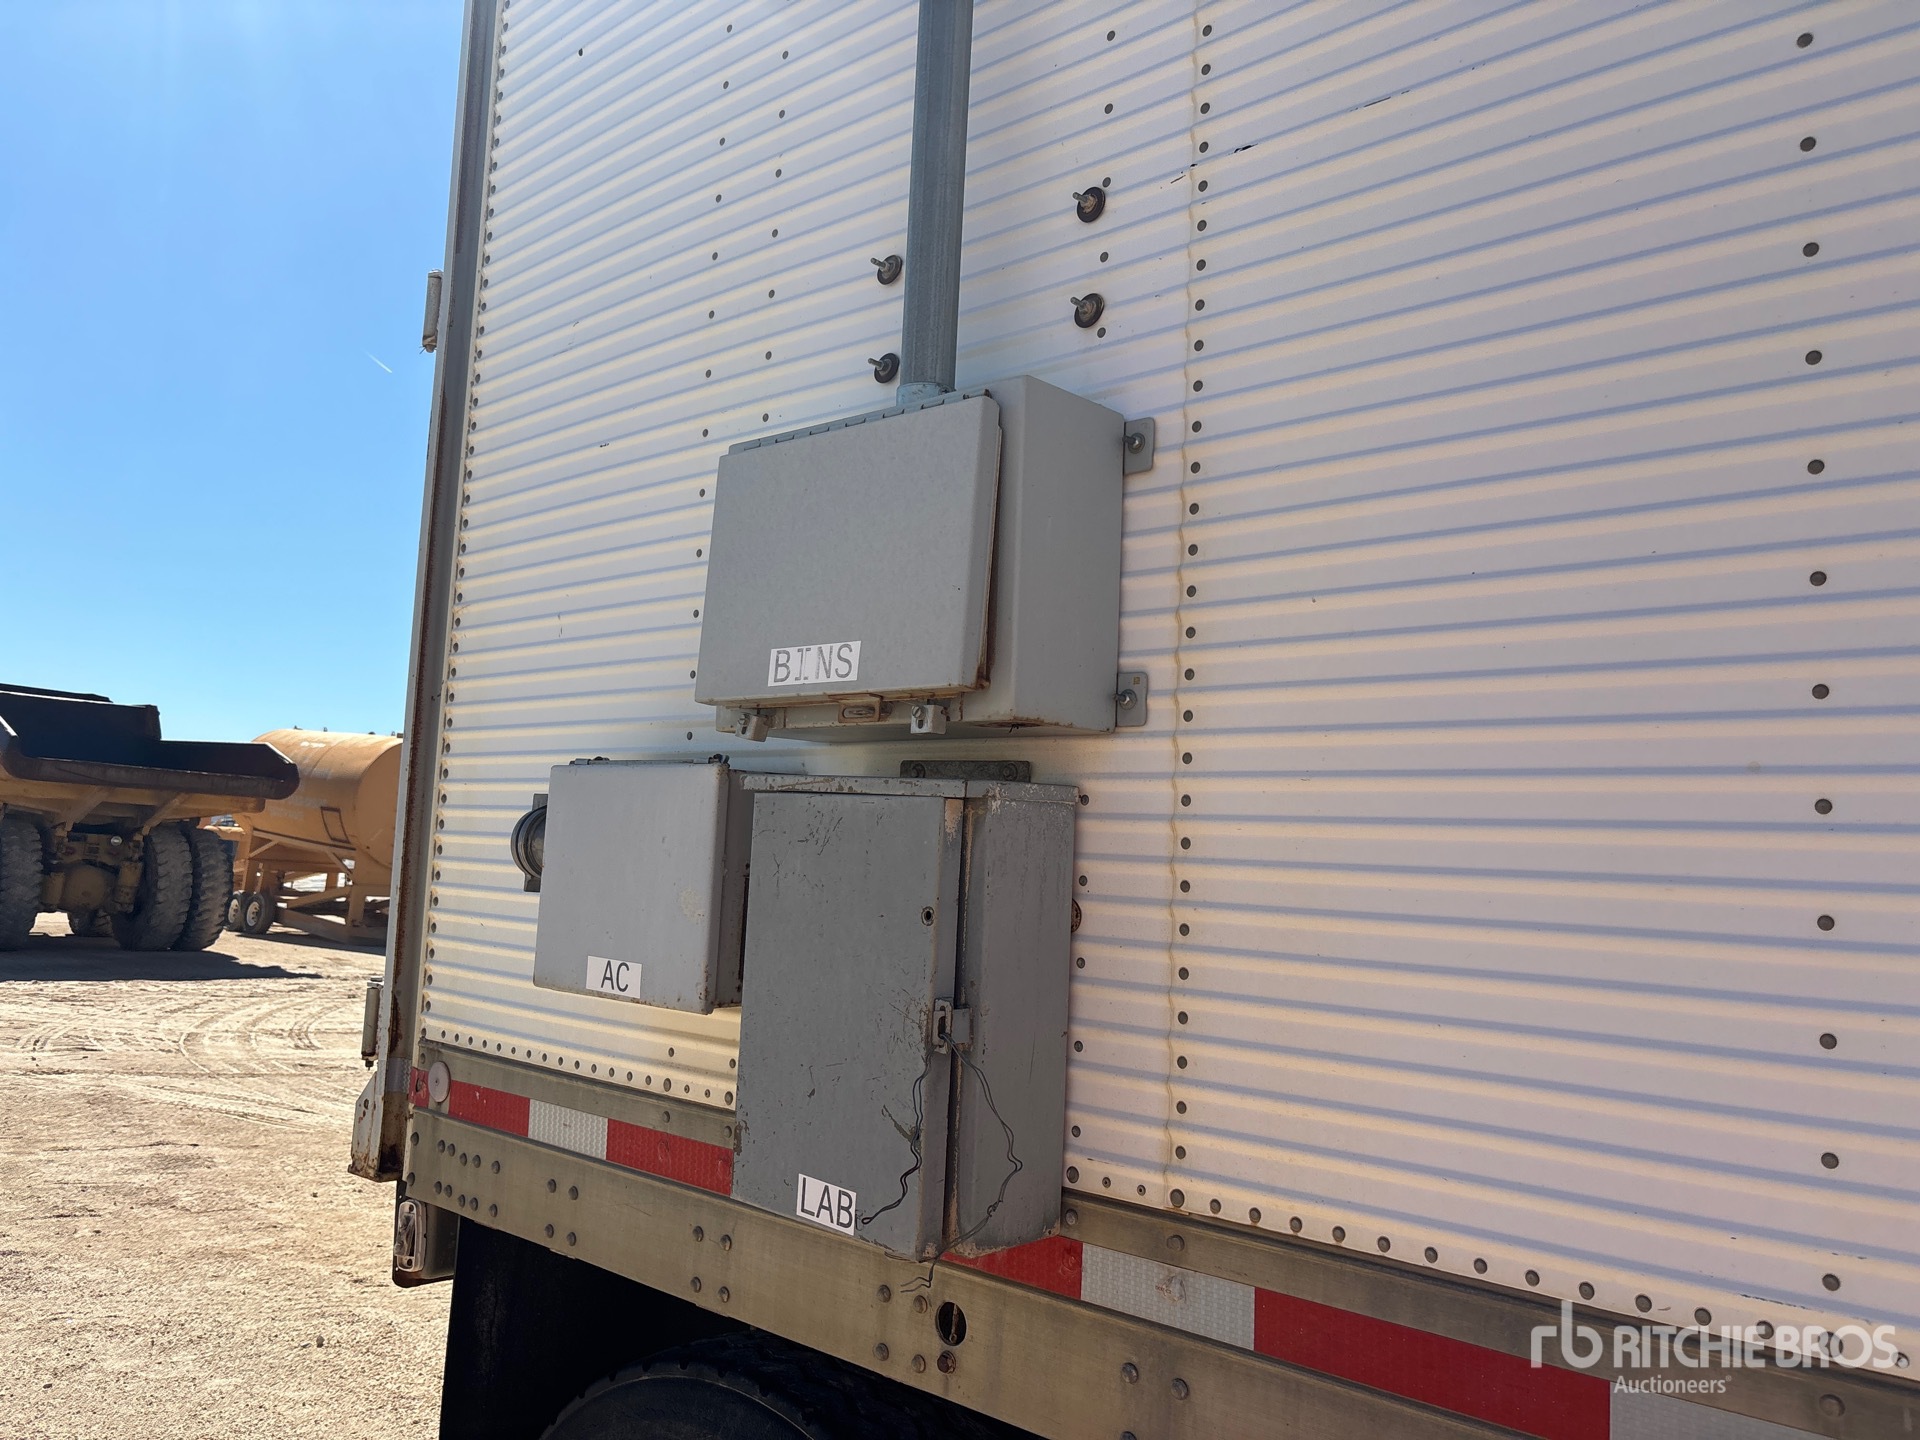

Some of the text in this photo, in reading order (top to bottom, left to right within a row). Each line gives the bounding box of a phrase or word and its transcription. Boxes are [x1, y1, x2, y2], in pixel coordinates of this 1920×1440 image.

[773, 643, 853, 683] BINS
[600, 959, 630, 993] AC
[800, 1176, 853, 1229] LAB
